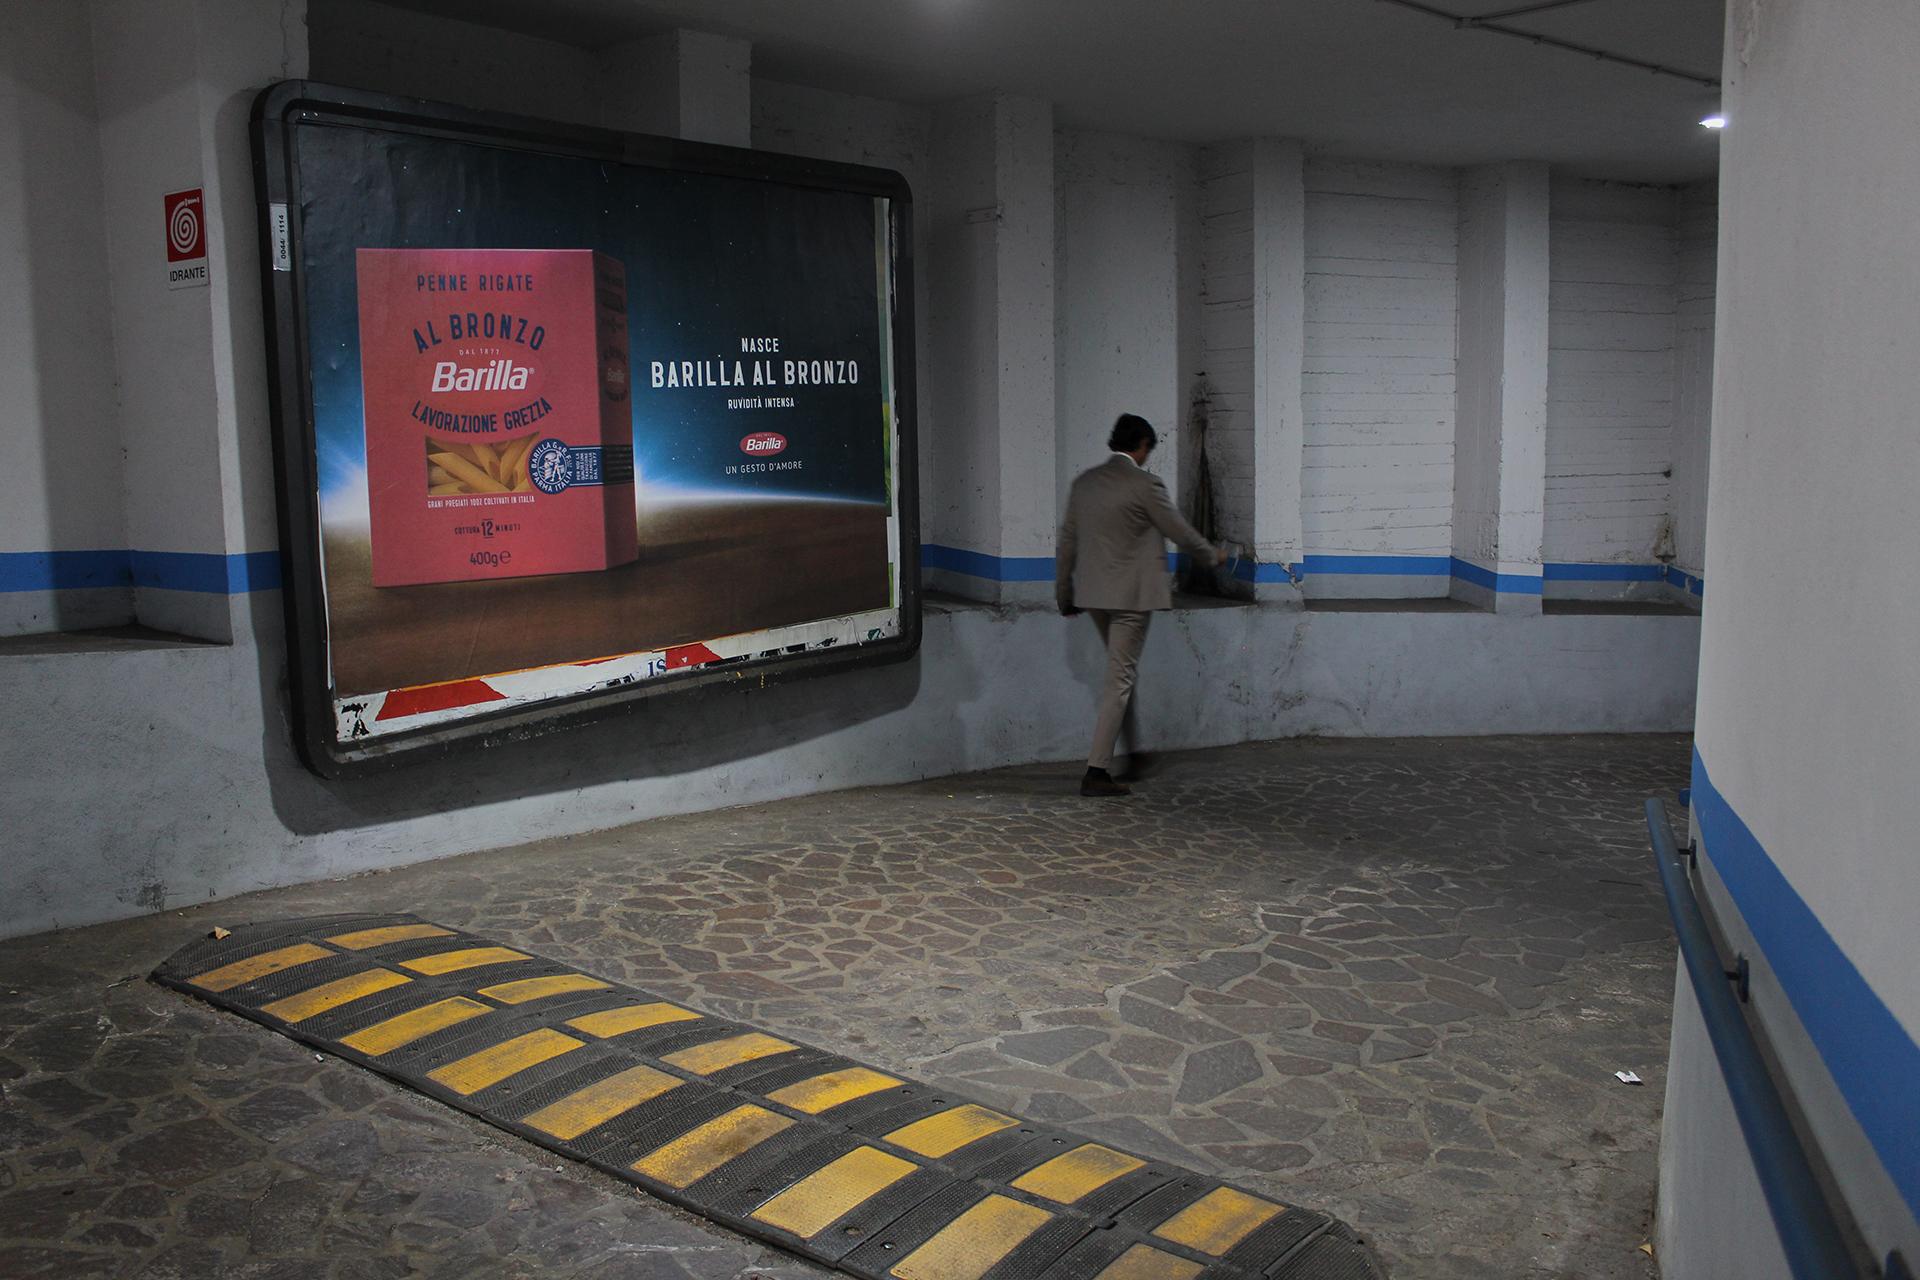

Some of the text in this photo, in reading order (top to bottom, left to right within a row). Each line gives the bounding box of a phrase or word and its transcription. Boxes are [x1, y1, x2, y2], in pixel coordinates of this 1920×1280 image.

[170, 266, 206, 282] IDRANTE
[417, 274, 533, 291] PENNE RIGATE
[412, 313, 545, 353] AL BRONZO
[741, 338, 780, 353] NASCE
[651, 361, 745, 388] BARILLA
[753, 360, 776, 386] AL
[784, 360, 859, 385] BRONZO
[728, 395, 795, 410] RUVIDITÀ INTENSA
[411, 397, 553, 433] LAVORAZIONE GREZZA
[725, 460, 802, 475] UN GESTO D'AMORE
[532, 472, 553, 492] PARMA
[554, 471, 573, 492] ITALIA
[427, 500, 444, 509] GRANI
[445, 498, 469, 508] PREGIATI
[483, 496, 509, 506] COLTIVATI
[510, 495, 517, 504] IN
[518, 495, 536, 504] ITALIA
[481, 520, 494, 537] 12
[496, 523, 521, 532] MINUTI
